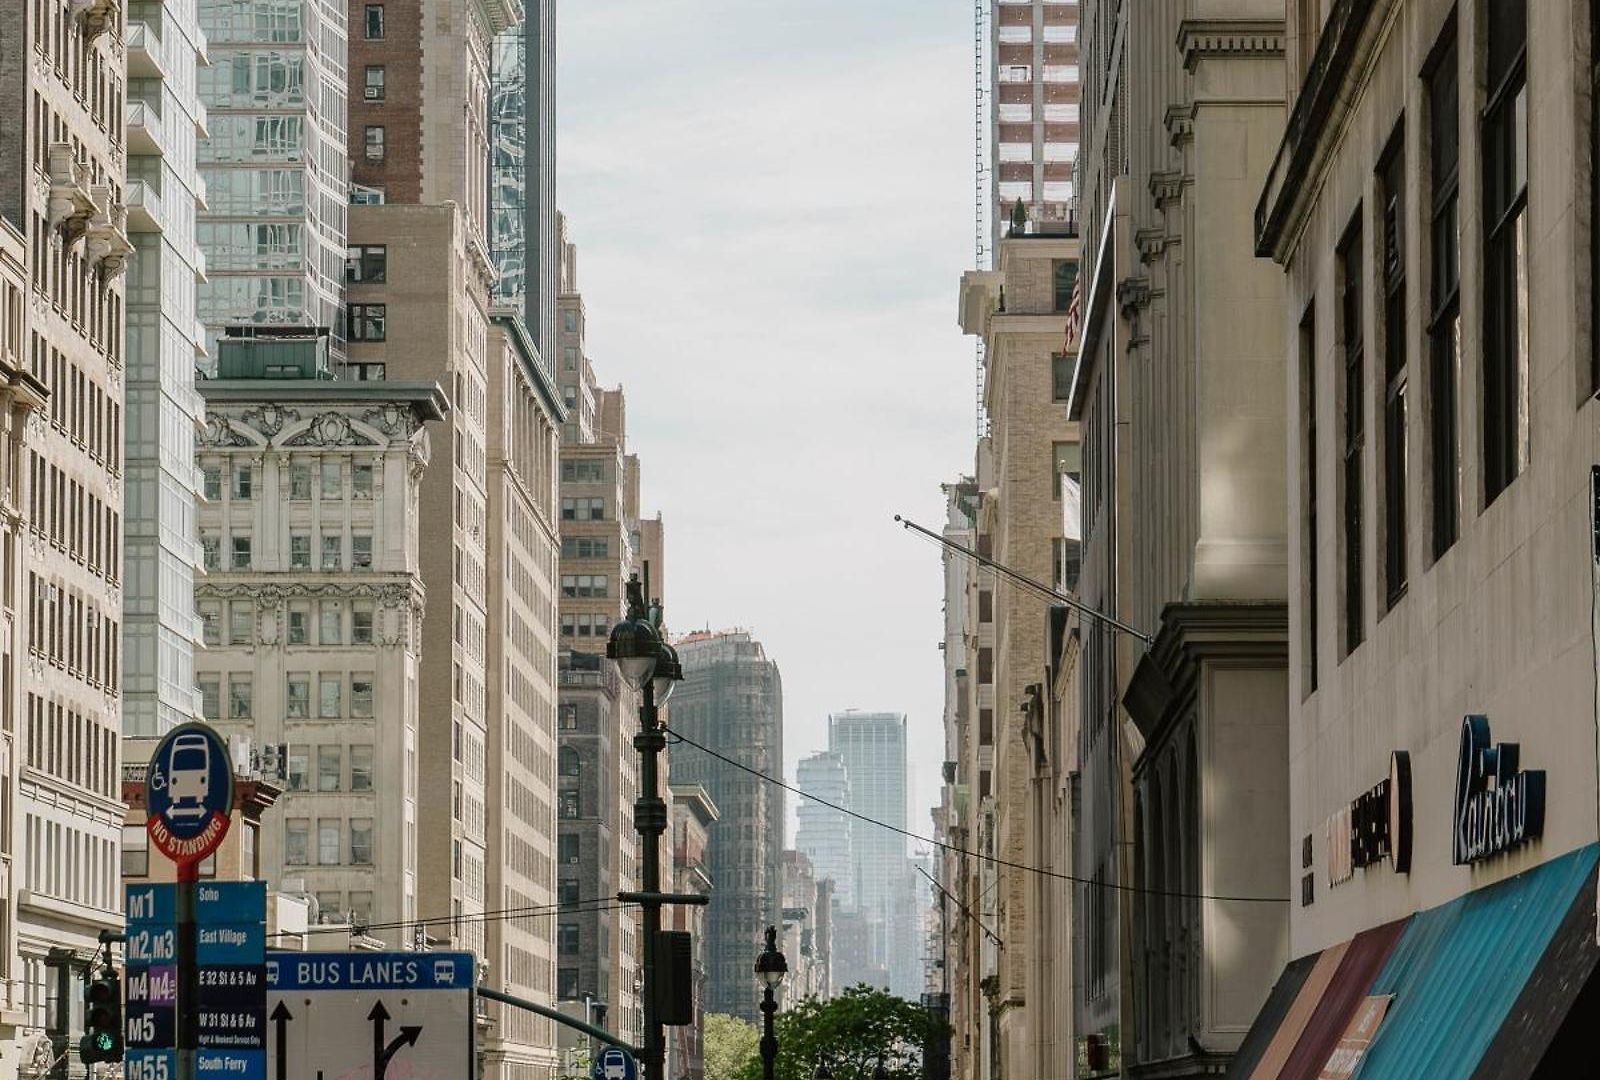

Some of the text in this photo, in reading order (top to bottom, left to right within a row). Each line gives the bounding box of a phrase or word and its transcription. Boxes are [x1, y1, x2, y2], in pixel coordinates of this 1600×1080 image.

[152, 818, 221, 856] NO STANDING
[129, 889, 155, 919] M1
[199, 887, 219, 902] Soho
[199, 929, 248, 946] East Village
[199, 971, 256, 985] E 32 St & 5 Av
[298, 961, 417, 984] BUS LANES
[128, 972, 148, 1001] M4
[128, 1013, 155, 1042] M5
[199, 1013, 207, 1027] W
[209, 1013, 218, 1027] 31
[220, 1013, 229, 1027] St
[230, 1013, 236, 1027] &
[245, 1013, 256, 1027] Av
[128, 1055, 168, 1080] M55
[198, 1056, 247, 1077] South Ferry
